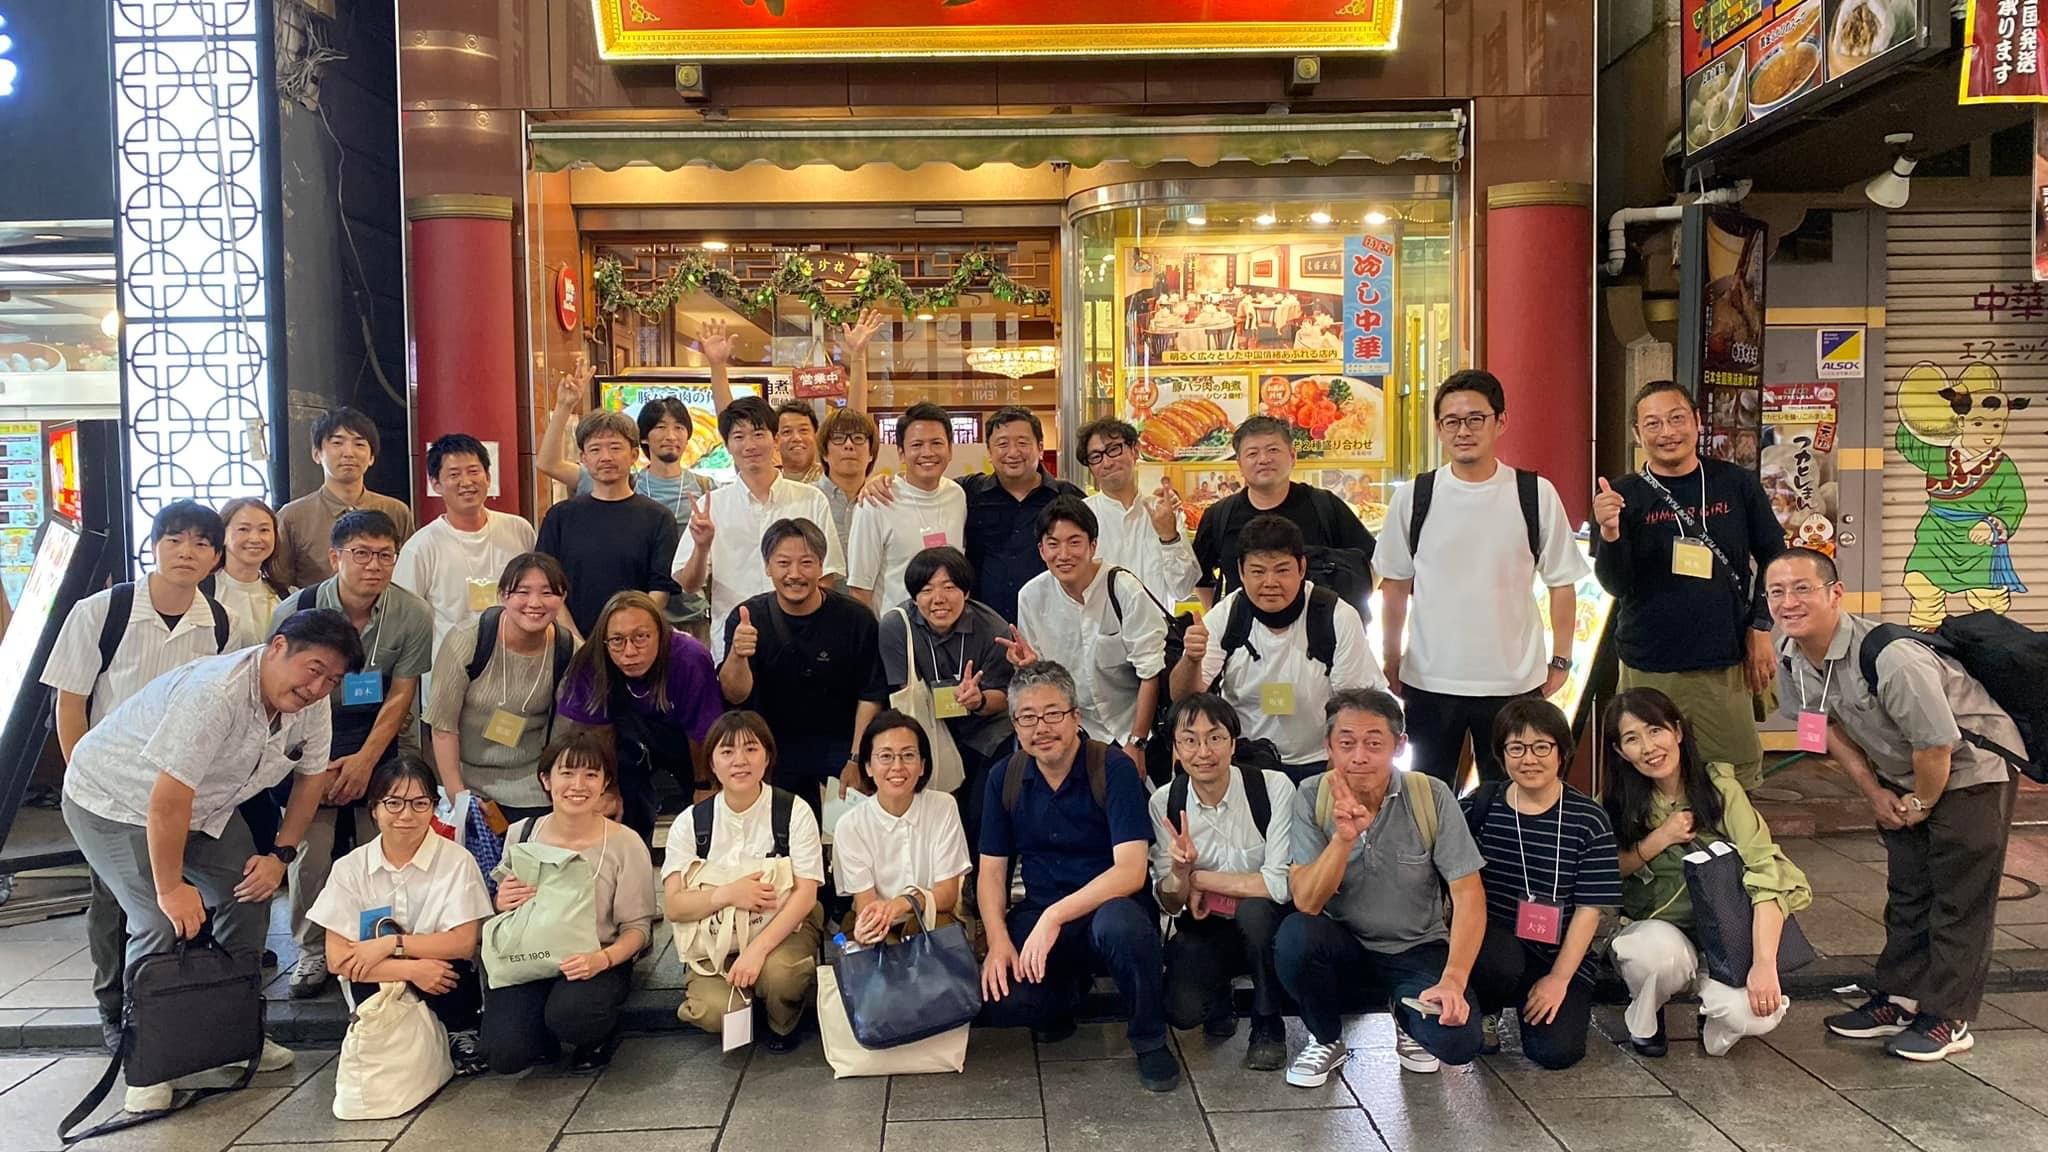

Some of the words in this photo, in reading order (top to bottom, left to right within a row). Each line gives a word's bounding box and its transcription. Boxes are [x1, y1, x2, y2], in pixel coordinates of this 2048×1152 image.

[1993, 0, 2018, 85] 承ります
[1353, 253, 1384, 360] 冷し中華
[800, 373, 838, 386] 営業中
[1645, 504, 1696, 524] UMBR
[529, 951, 551, 960] 1908
